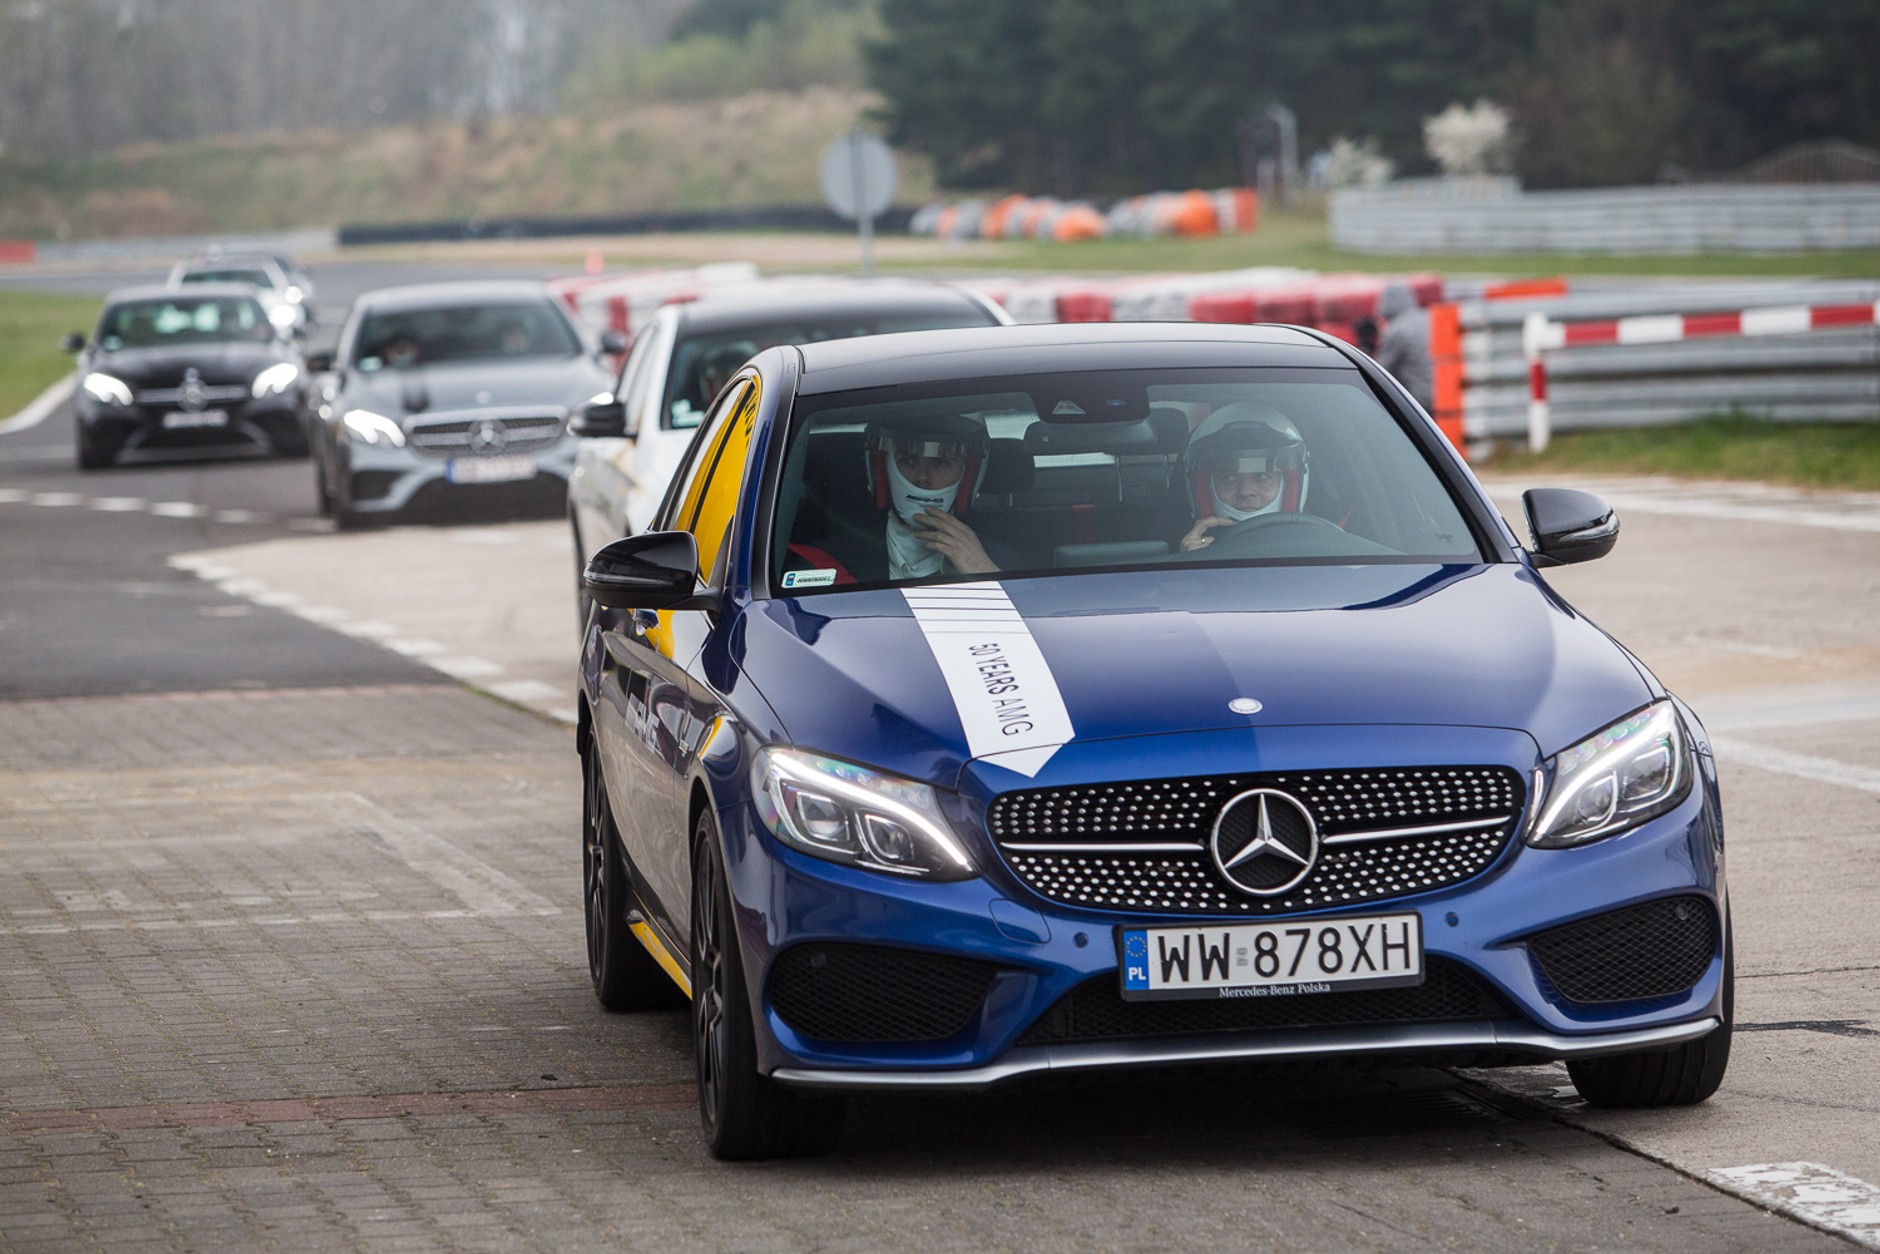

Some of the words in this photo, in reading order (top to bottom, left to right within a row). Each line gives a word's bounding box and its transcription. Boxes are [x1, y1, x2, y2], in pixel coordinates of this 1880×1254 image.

[968, 642, 1001, 656] 50
[976, 655, 1019, 695] YEARS
[992, 698, 1034, 737] AMG
[1158, 932, 1231, 983] WW
[1254, 921, 1411, 978] 878XH
[1128, 966, 1147, 981] PL
[1219, 985, 1295, 998] Mercedes-Benz
[1298, 982, 1331, 994] Polska
